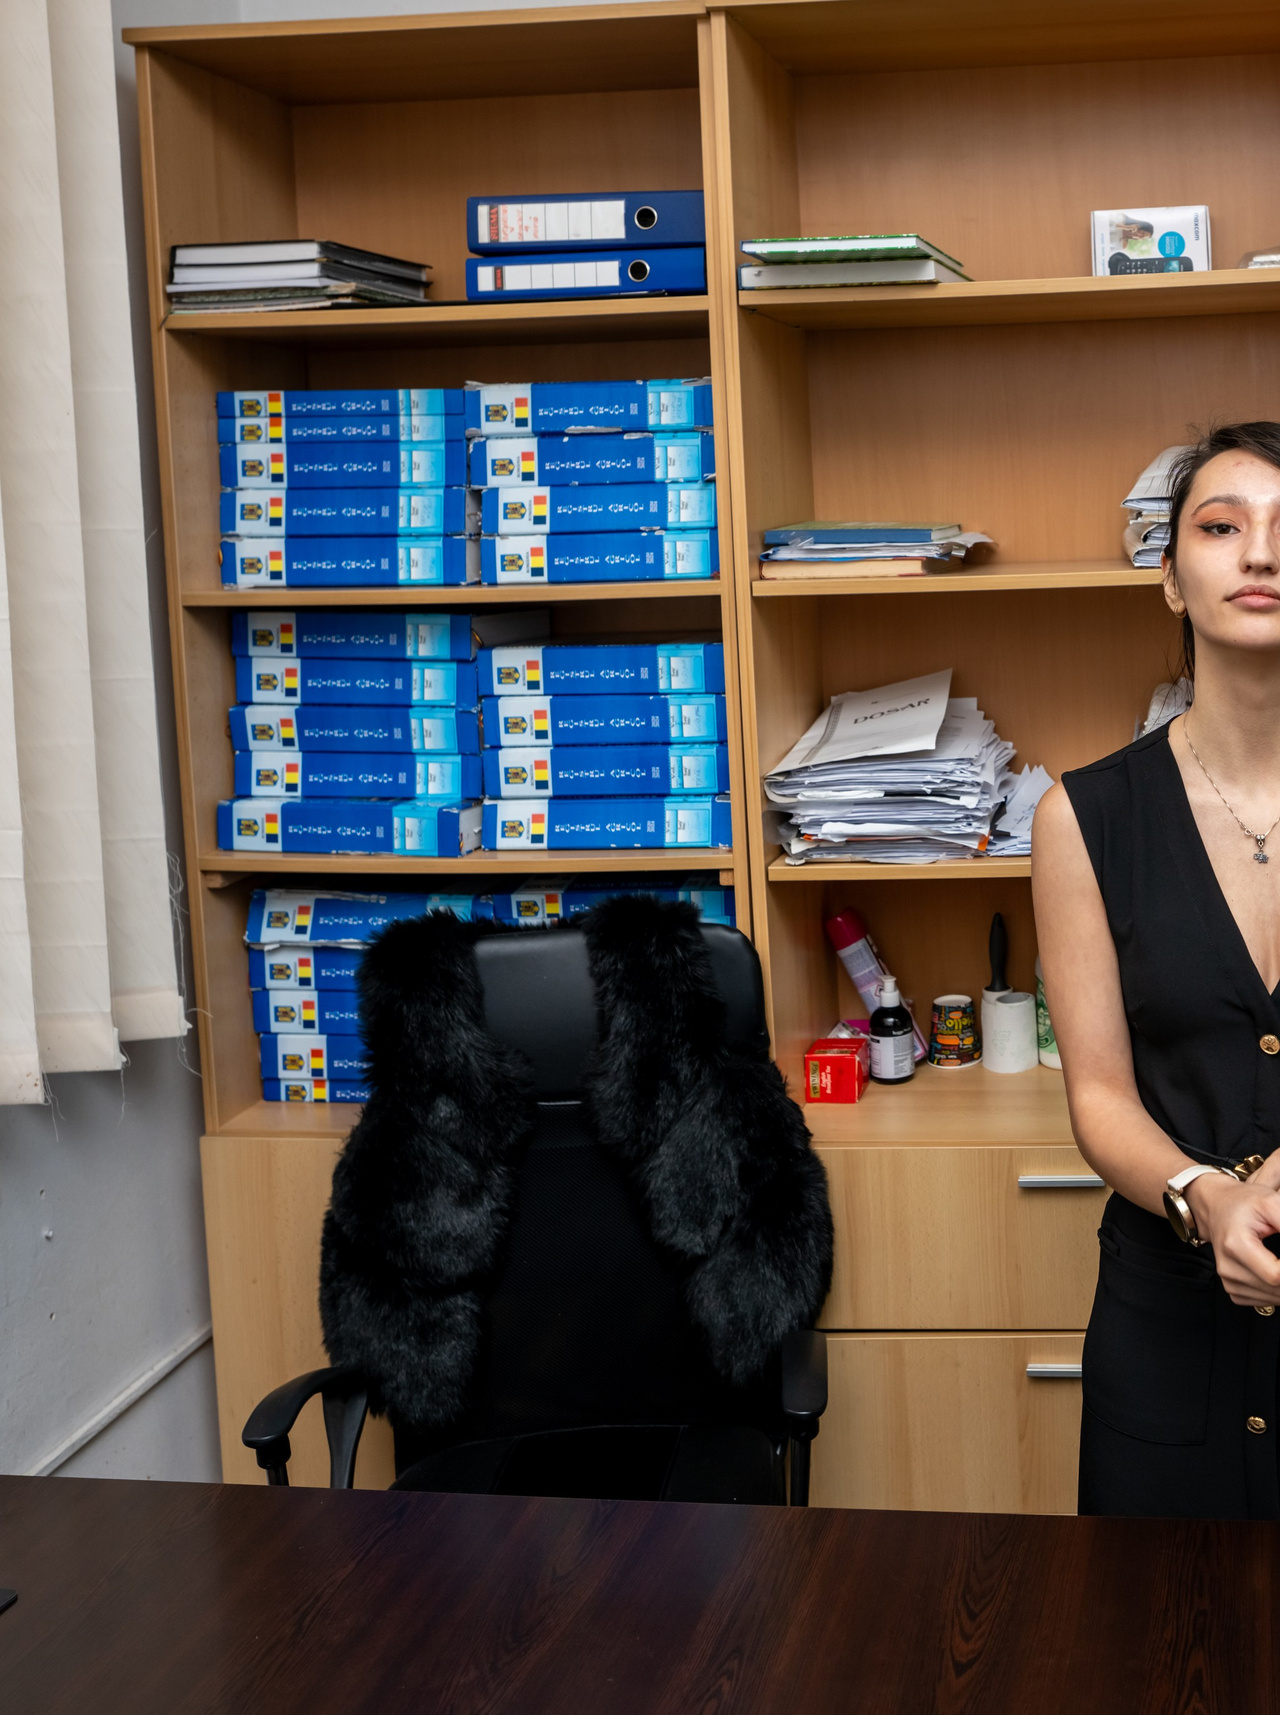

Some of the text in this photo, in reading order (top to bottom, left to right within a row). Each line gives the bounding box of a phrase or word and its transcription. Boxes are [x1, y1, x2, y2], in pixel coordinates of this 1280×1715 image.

[490, 207, 498, 240] SIGMA
[539, 405, 624, 416] REGISTRUL AGRICOL
[545, 459, 631, 470] REGISTRUL AGRICOL
[557, 503, 644, 514] REGISTRUL AGRICOL
[555, 554, 640, 565] REGISTRUL AGRICOL
[550, 669, 634, 679] REGISTRUL AGRICOL
[853, 698, 930, 724] DOSAR
[559, 718, 645, 728] REGISTRUL AGRICOL
[559, 768, 646, 779] REGISTRUL AGRICOL
[555, 822, 641, 832] REGISTRUL AGRICOL
